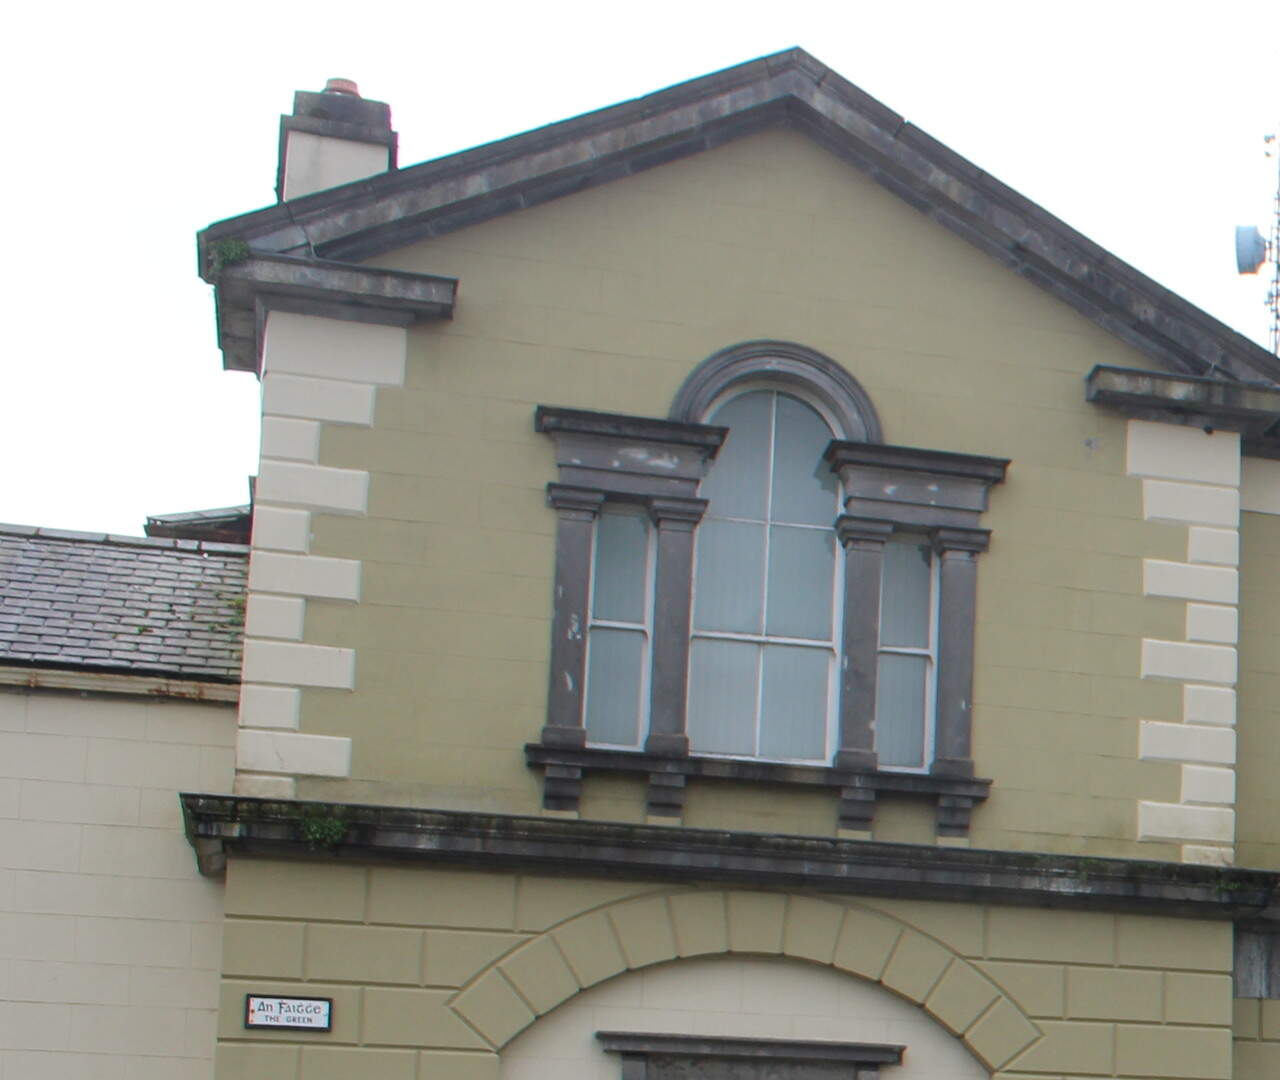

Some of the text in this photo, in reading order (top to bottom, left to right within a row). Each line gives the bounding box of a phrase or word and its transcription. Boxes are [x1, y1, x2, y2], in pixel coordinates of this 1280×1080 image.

[257, 1001, 273, 1012] An
[264, 1015, 313, 1024] THE GREEN
